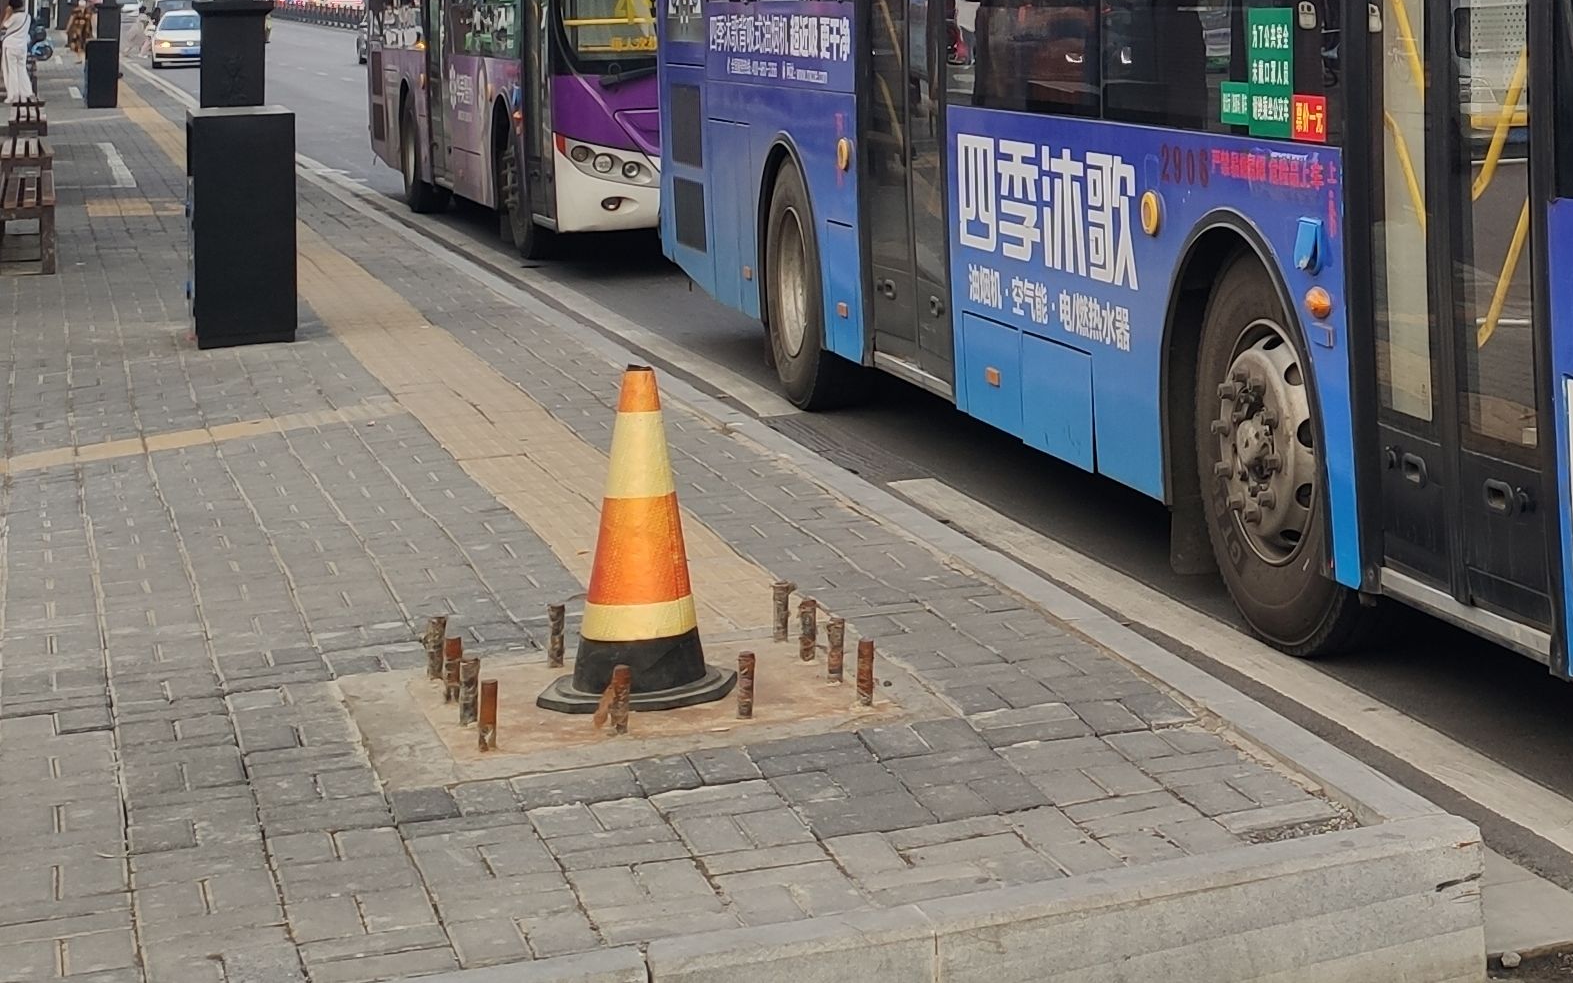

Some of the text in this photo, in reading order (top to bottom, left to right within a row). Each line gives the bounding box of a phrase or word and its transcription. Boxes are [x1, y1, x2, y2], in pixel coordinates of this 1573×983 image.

[1251, 24, 1289, 49] 为了公共安全
[1251, 59, 1289, 85] 未戴口罩人员
[1295, 101, 1323, 133] 票价一元
[957, 133, 1140, 291] 四季沐歌
